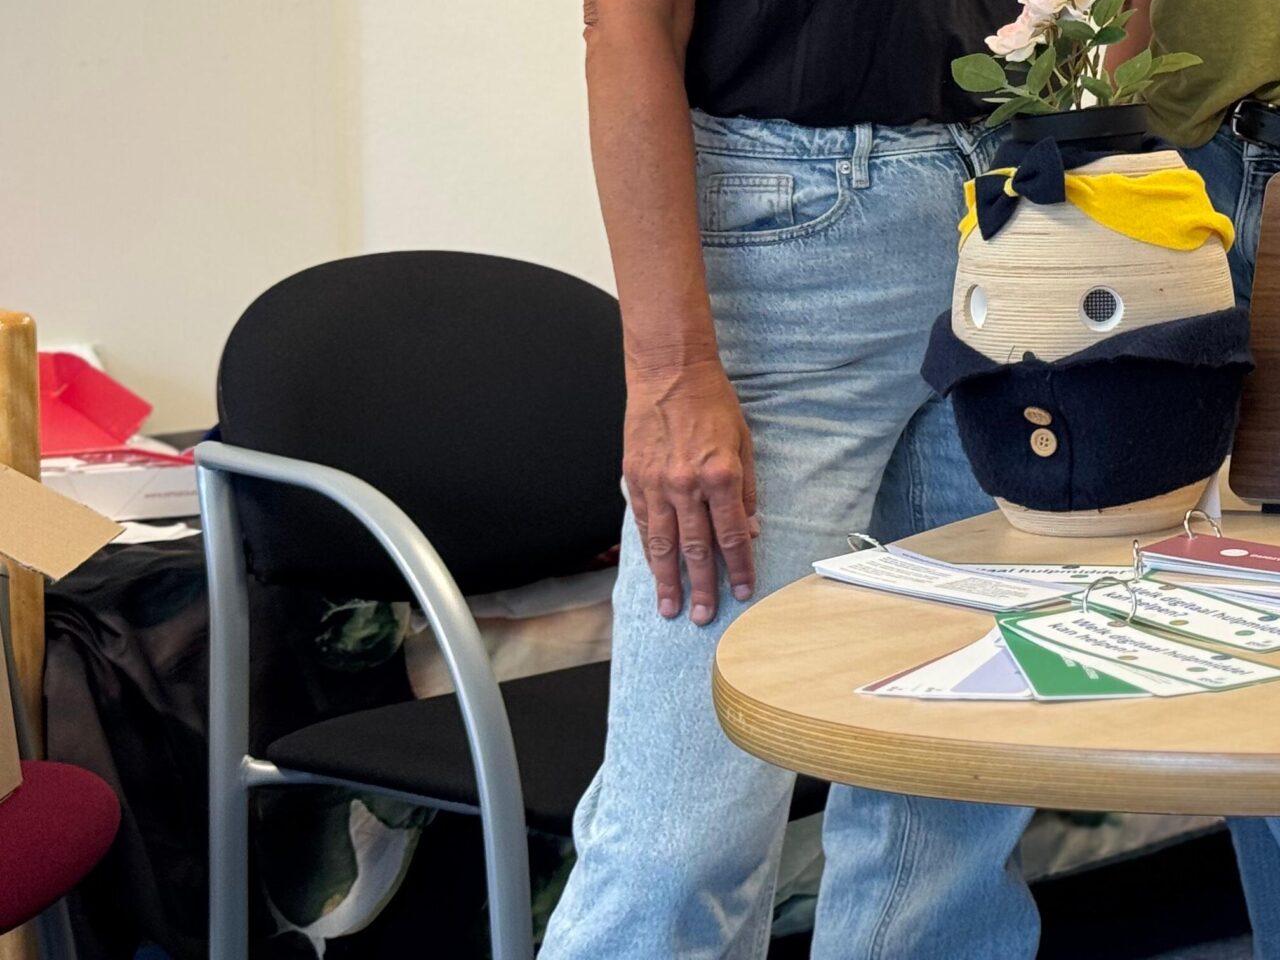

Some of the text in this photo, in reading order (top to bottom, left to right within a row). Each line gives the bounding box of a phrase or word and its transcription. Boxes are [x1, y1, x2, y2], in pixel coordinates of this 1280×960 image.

[1103, 591, 1131, 604] kan
[1160, 596, 1213, 617] digitaal
[1048, 622, 1138, 654] kan helpen?
[1072, 617, 1255, 677] Welk digitaal hulpmiddel
